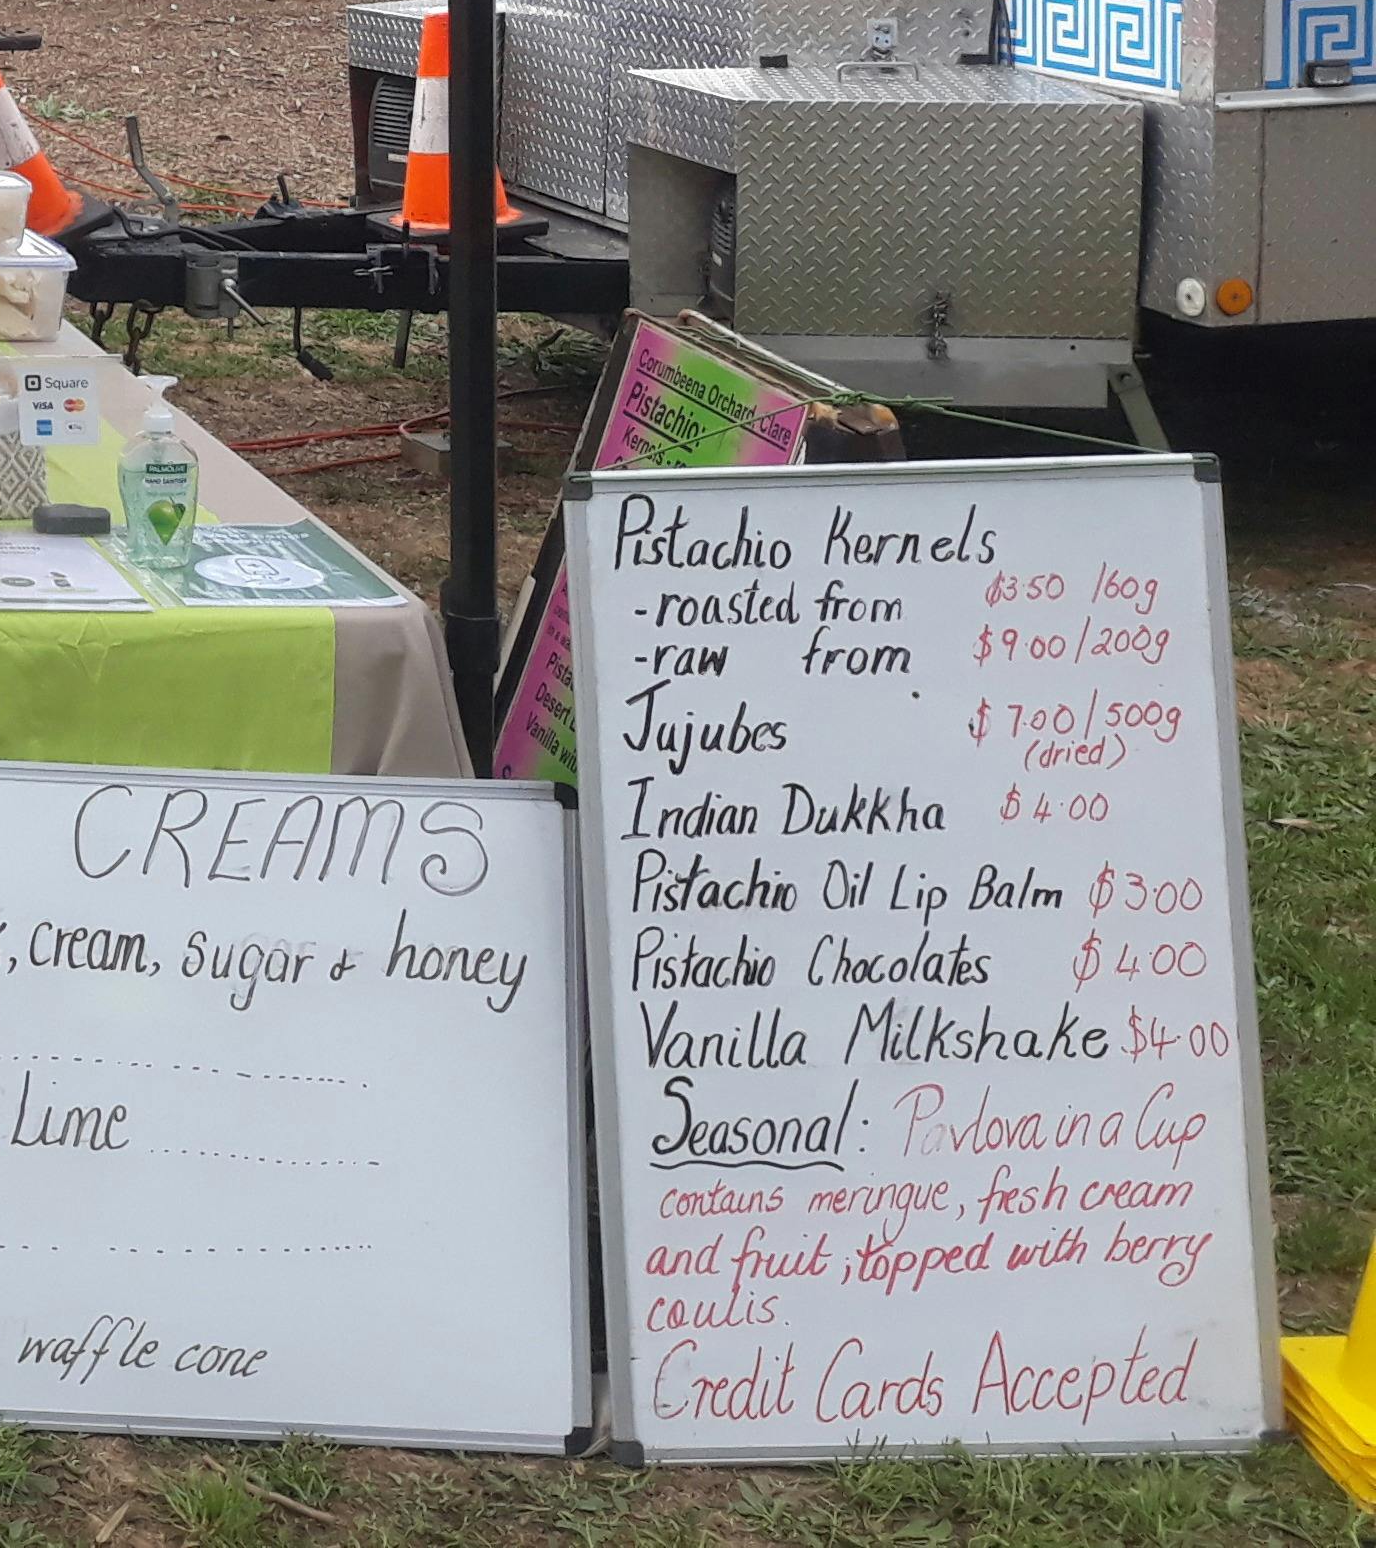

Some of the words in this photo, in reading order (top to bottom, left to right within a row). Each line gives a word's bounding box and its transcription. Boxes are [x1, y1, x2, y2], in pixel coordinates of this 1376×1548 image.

[32, 401, 54, 410] VISA
[44, 377, 89, 390] Square
[638, 348, 706, 401] Corumbeena
[759, 414, 792, 446] Clare
[614, 493, 792, 571] Pistachio
[823, 503, 997, 566] Kernels
[814, 579, 904, 625] from
[801, 626, 912, 677] from
[525, 710, 561, 757] Vanilla
[535, 681, 569, 726] Desert
[622, 678, 788, 775] Jujubes
[1024, 733, 1127, 773] (dried)
[74, 784, 490, 897] CREAMS
[619, 775, 758, 841] Indian
[781, 782, 947, 837] Dukkha
[631, 848, 798, 914] Pistachio
[822, 856, 871, 913] Oil
[889, 861, 949, 926] Lip
[967, 863, 1065, 913] Balm
[28, 922, 160, 977] cream,
[384, 909, 529, 1014] honey
[631, 926, 776, 994] Pistachio
[807, 932, 990, 986] Chocolates
[639, 1001, 808, 1070] Vanilla
[844, 1002, 1110, 1068] Milkshake
[10, 1068, 132, 1152] Lime
[1052, 1103, 1088, 1150] in
[1099, 1113, 1118, 1146] a
[1132, 1081, 1208, 1171] Cup
[659, 1176, 784, 1219] contains
[807, 1172, 967, 1242] meringue,
[978, 1165, 1069, 1226] fresh
[1079, 1176, 1194, 1212] cream
[646, 1233, 721, 1278] and
[856, 1232, 991, 1295] topped
[1006, 1226, 1088, 1271] with
[1102, 1222, 1213, 1288] berry
[645, 1285, 791, 1332] coulis.
[17, 1313, 158, 1385] waffle
[174, 1344, 271, 1380] cone
[652, 1336, 795, 1423] Credit
[815, 1337, 944, 1424] Cards
[970, 1325, 1200, 1426] Accepted
